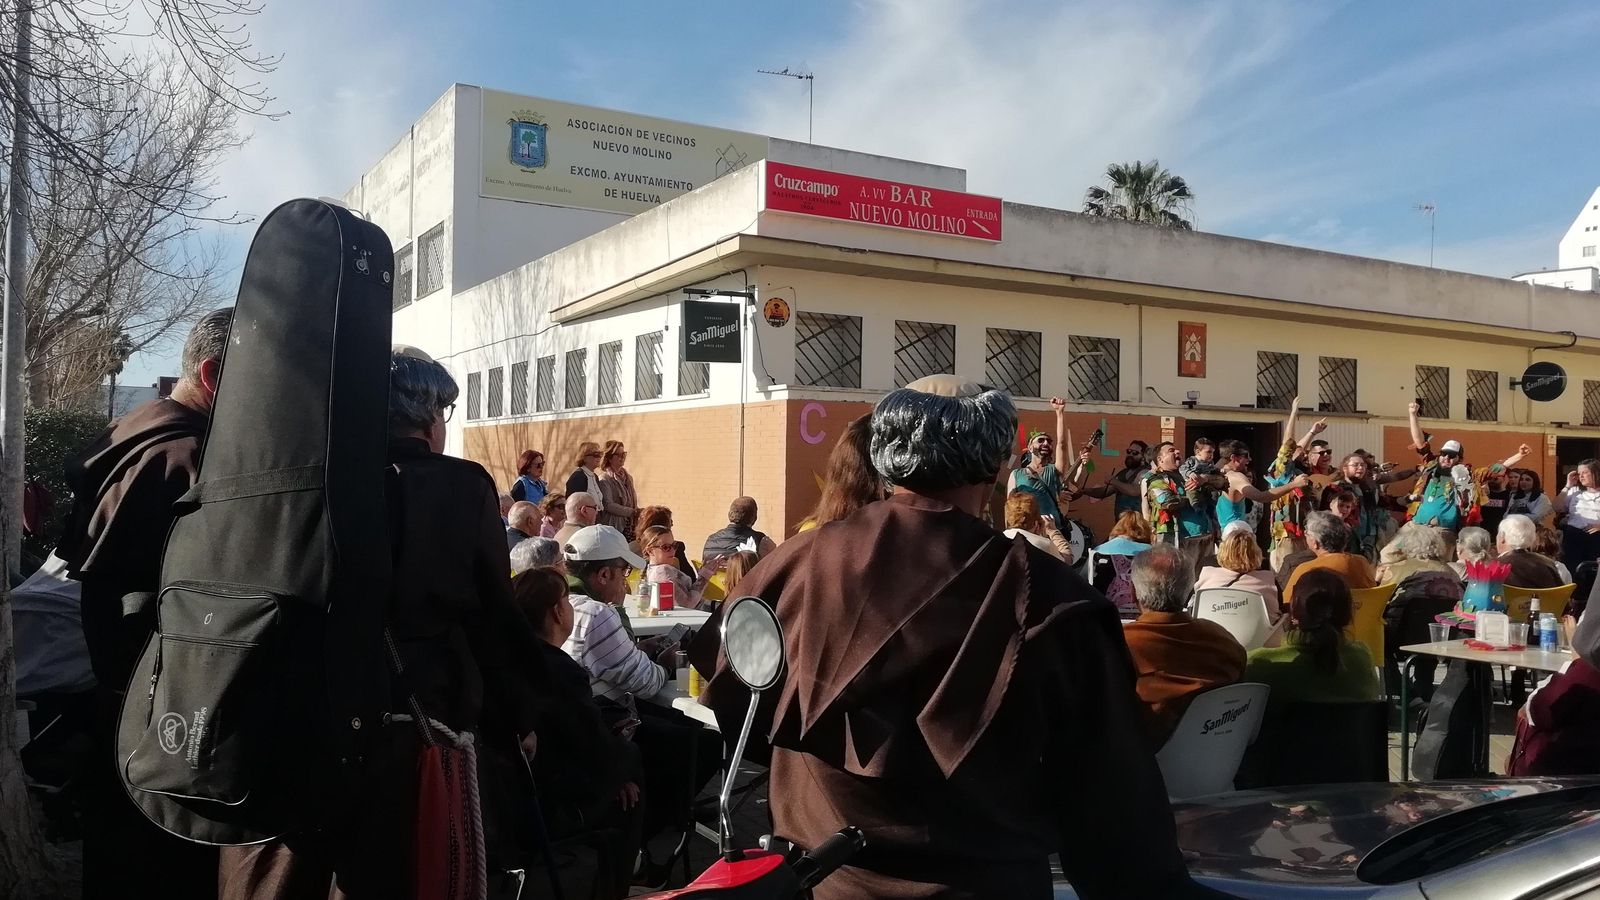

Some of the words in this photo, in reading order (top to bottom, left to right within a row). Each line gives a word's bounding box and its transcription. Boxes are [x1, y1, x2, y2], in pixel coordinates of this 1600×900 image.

[636, 128, 649, 140] DE
[652, 132, 696, 148] VECINOS
[593, 140, 629, 155] NUEVO
[632, 146, 672, 161] MOLINO
[570, 165, 611, 180] EXCMO.
[613, 171, 693, 191] AYUNTAMIENTO
[774, 173, 839, 197] Cruzcampo
[604, 187, 618, 199] DE
[621, 189, 661, 204] HUELVA
[873, 189, 886, 201] VV
[890, 185, 934, 209] BAR
[849, 201, 902, 226] NUEVO
[908, 211, 967, 235] MOLINO
[966, 208, 998, 221] ENTRADA
